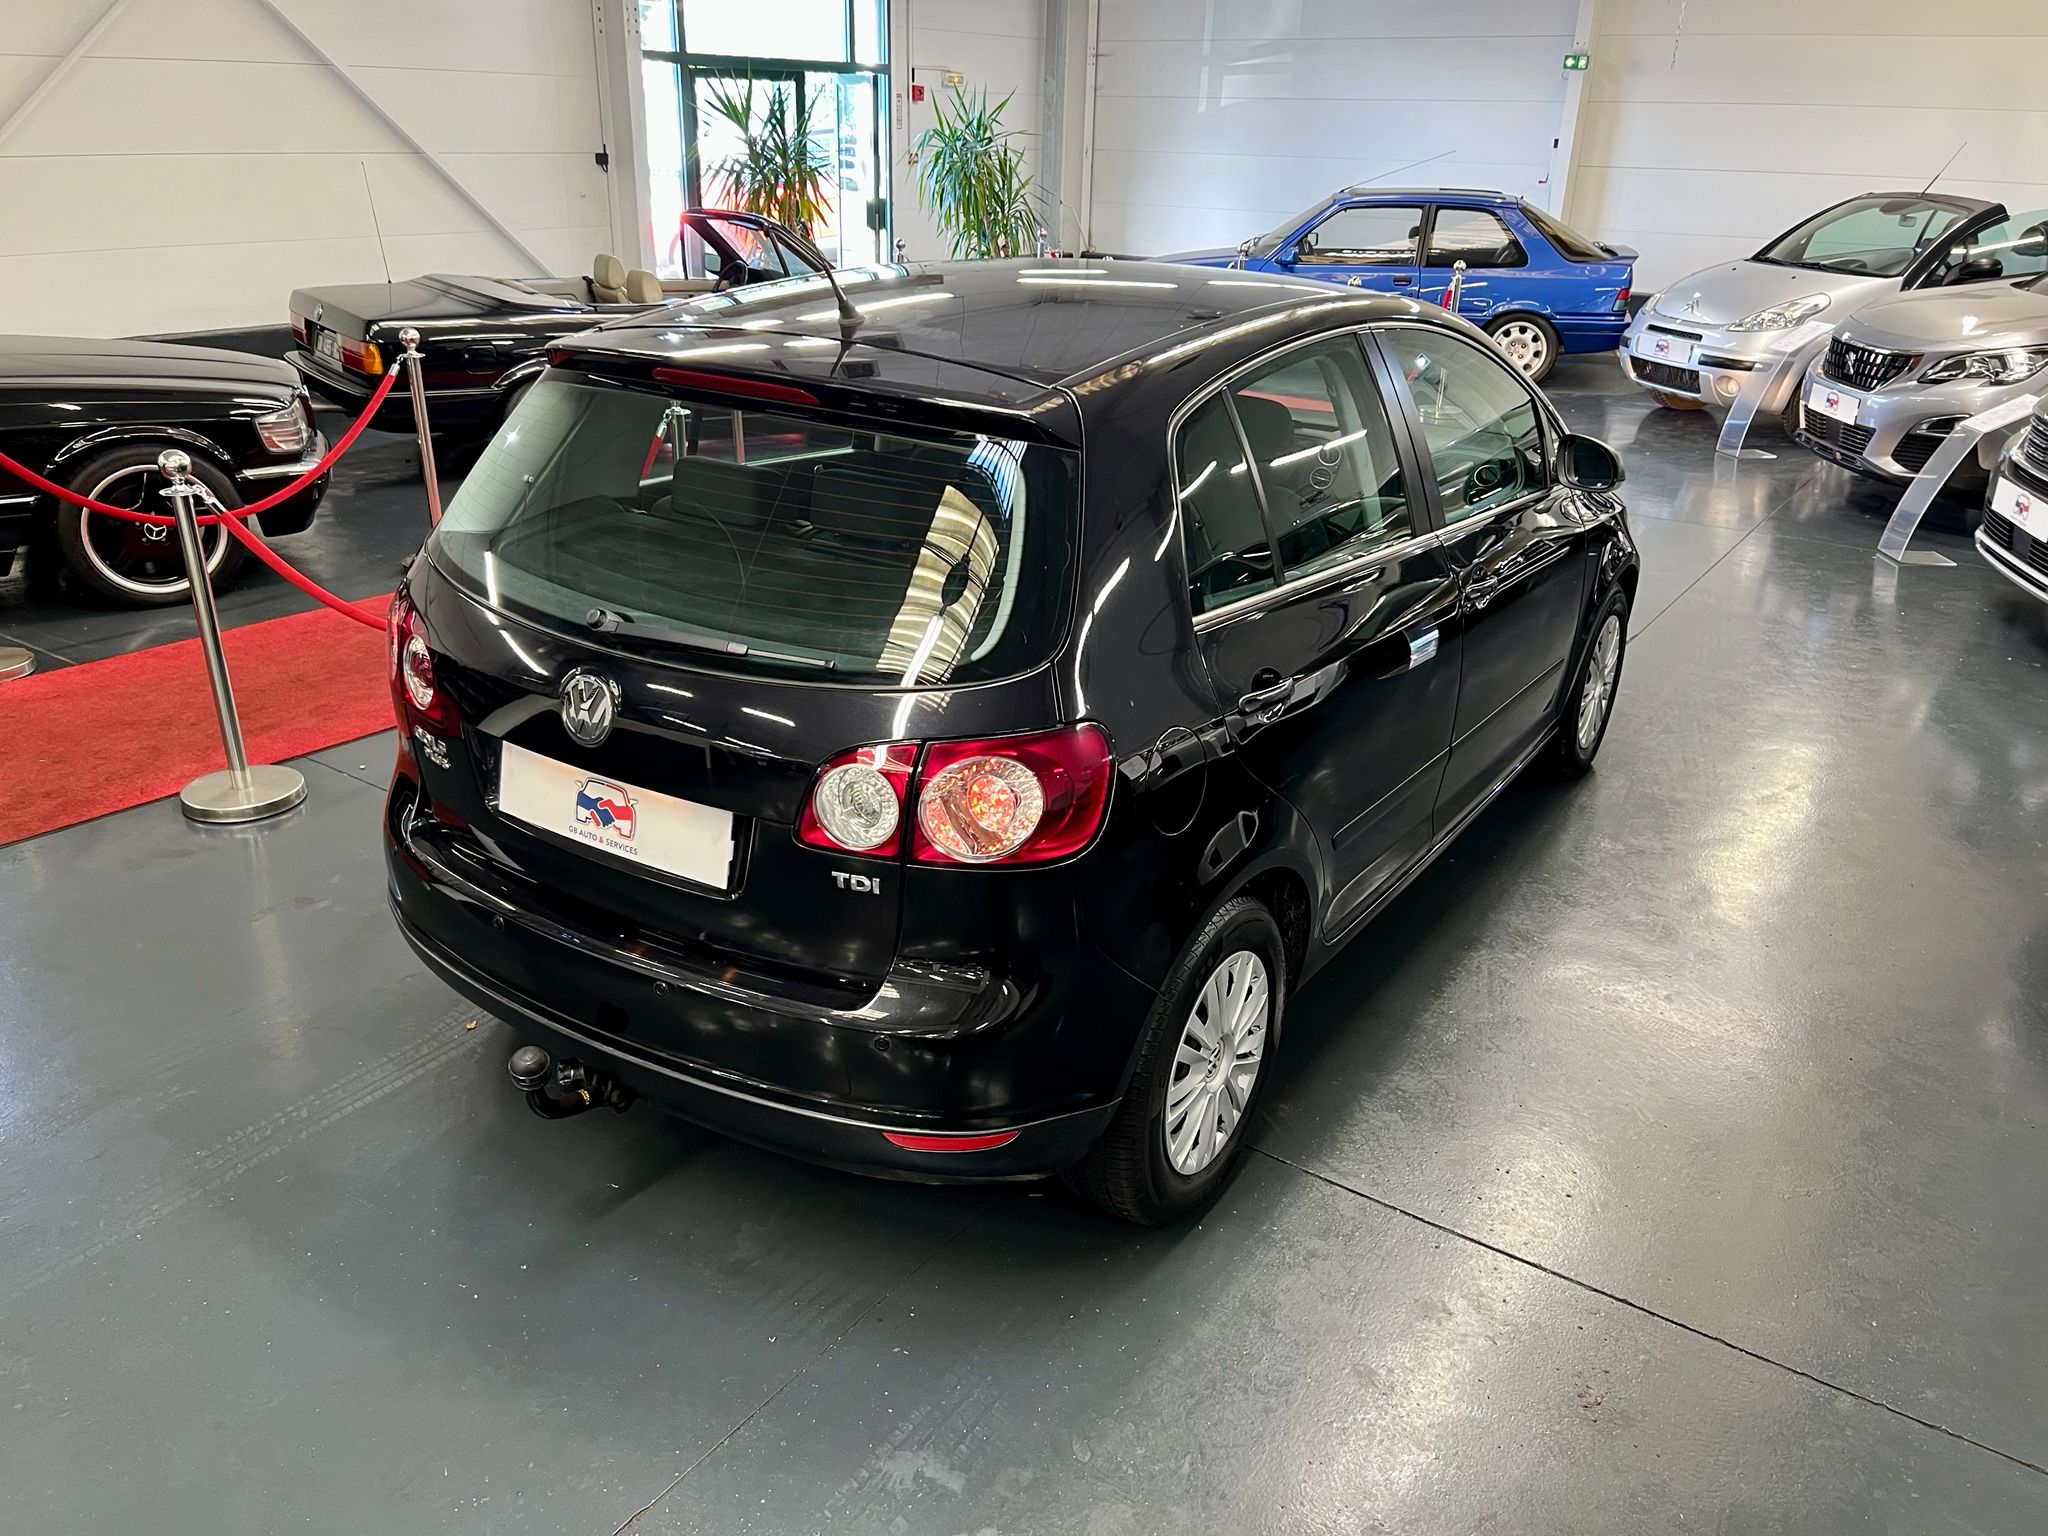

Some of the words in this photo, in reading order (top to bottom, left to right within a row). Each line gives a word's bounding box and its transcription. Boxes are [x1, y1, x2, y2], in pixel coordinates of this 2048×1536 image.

[568, 825, 578, 834] GB
[579, 829, 598, 841] AUTO
[598, 836, 604, 844] &
[605, 838, 638, 856] SERVICES
[831, 871, 880, 895] TDI
